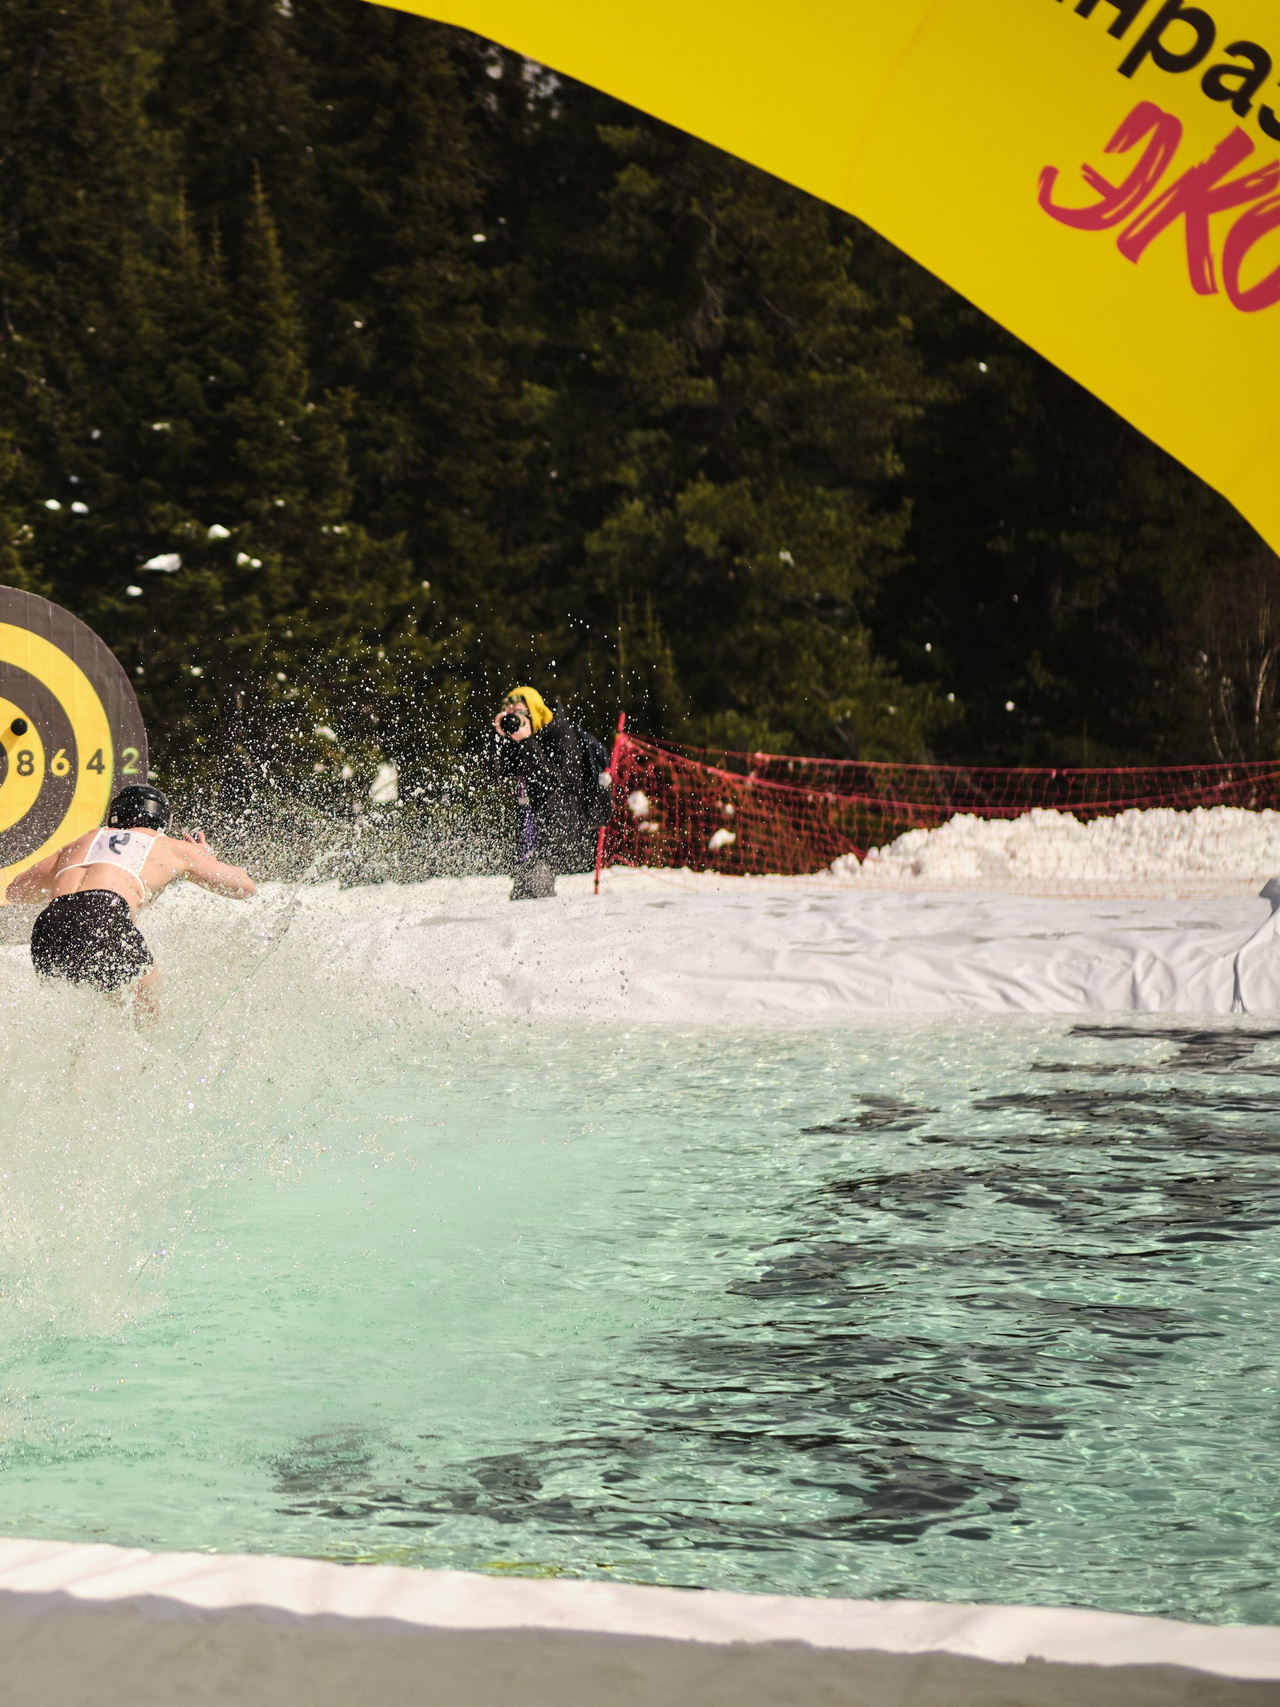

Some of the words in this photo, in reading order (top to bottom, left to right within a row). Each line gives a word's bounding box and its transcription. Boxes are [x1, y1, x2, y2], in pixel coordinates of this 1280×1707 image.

[16, 749, 35, 776] 8
[51, 749, 70, 777] 6
[86, 748, 106, 775] 4
[122, 747, 139, 775] 2
